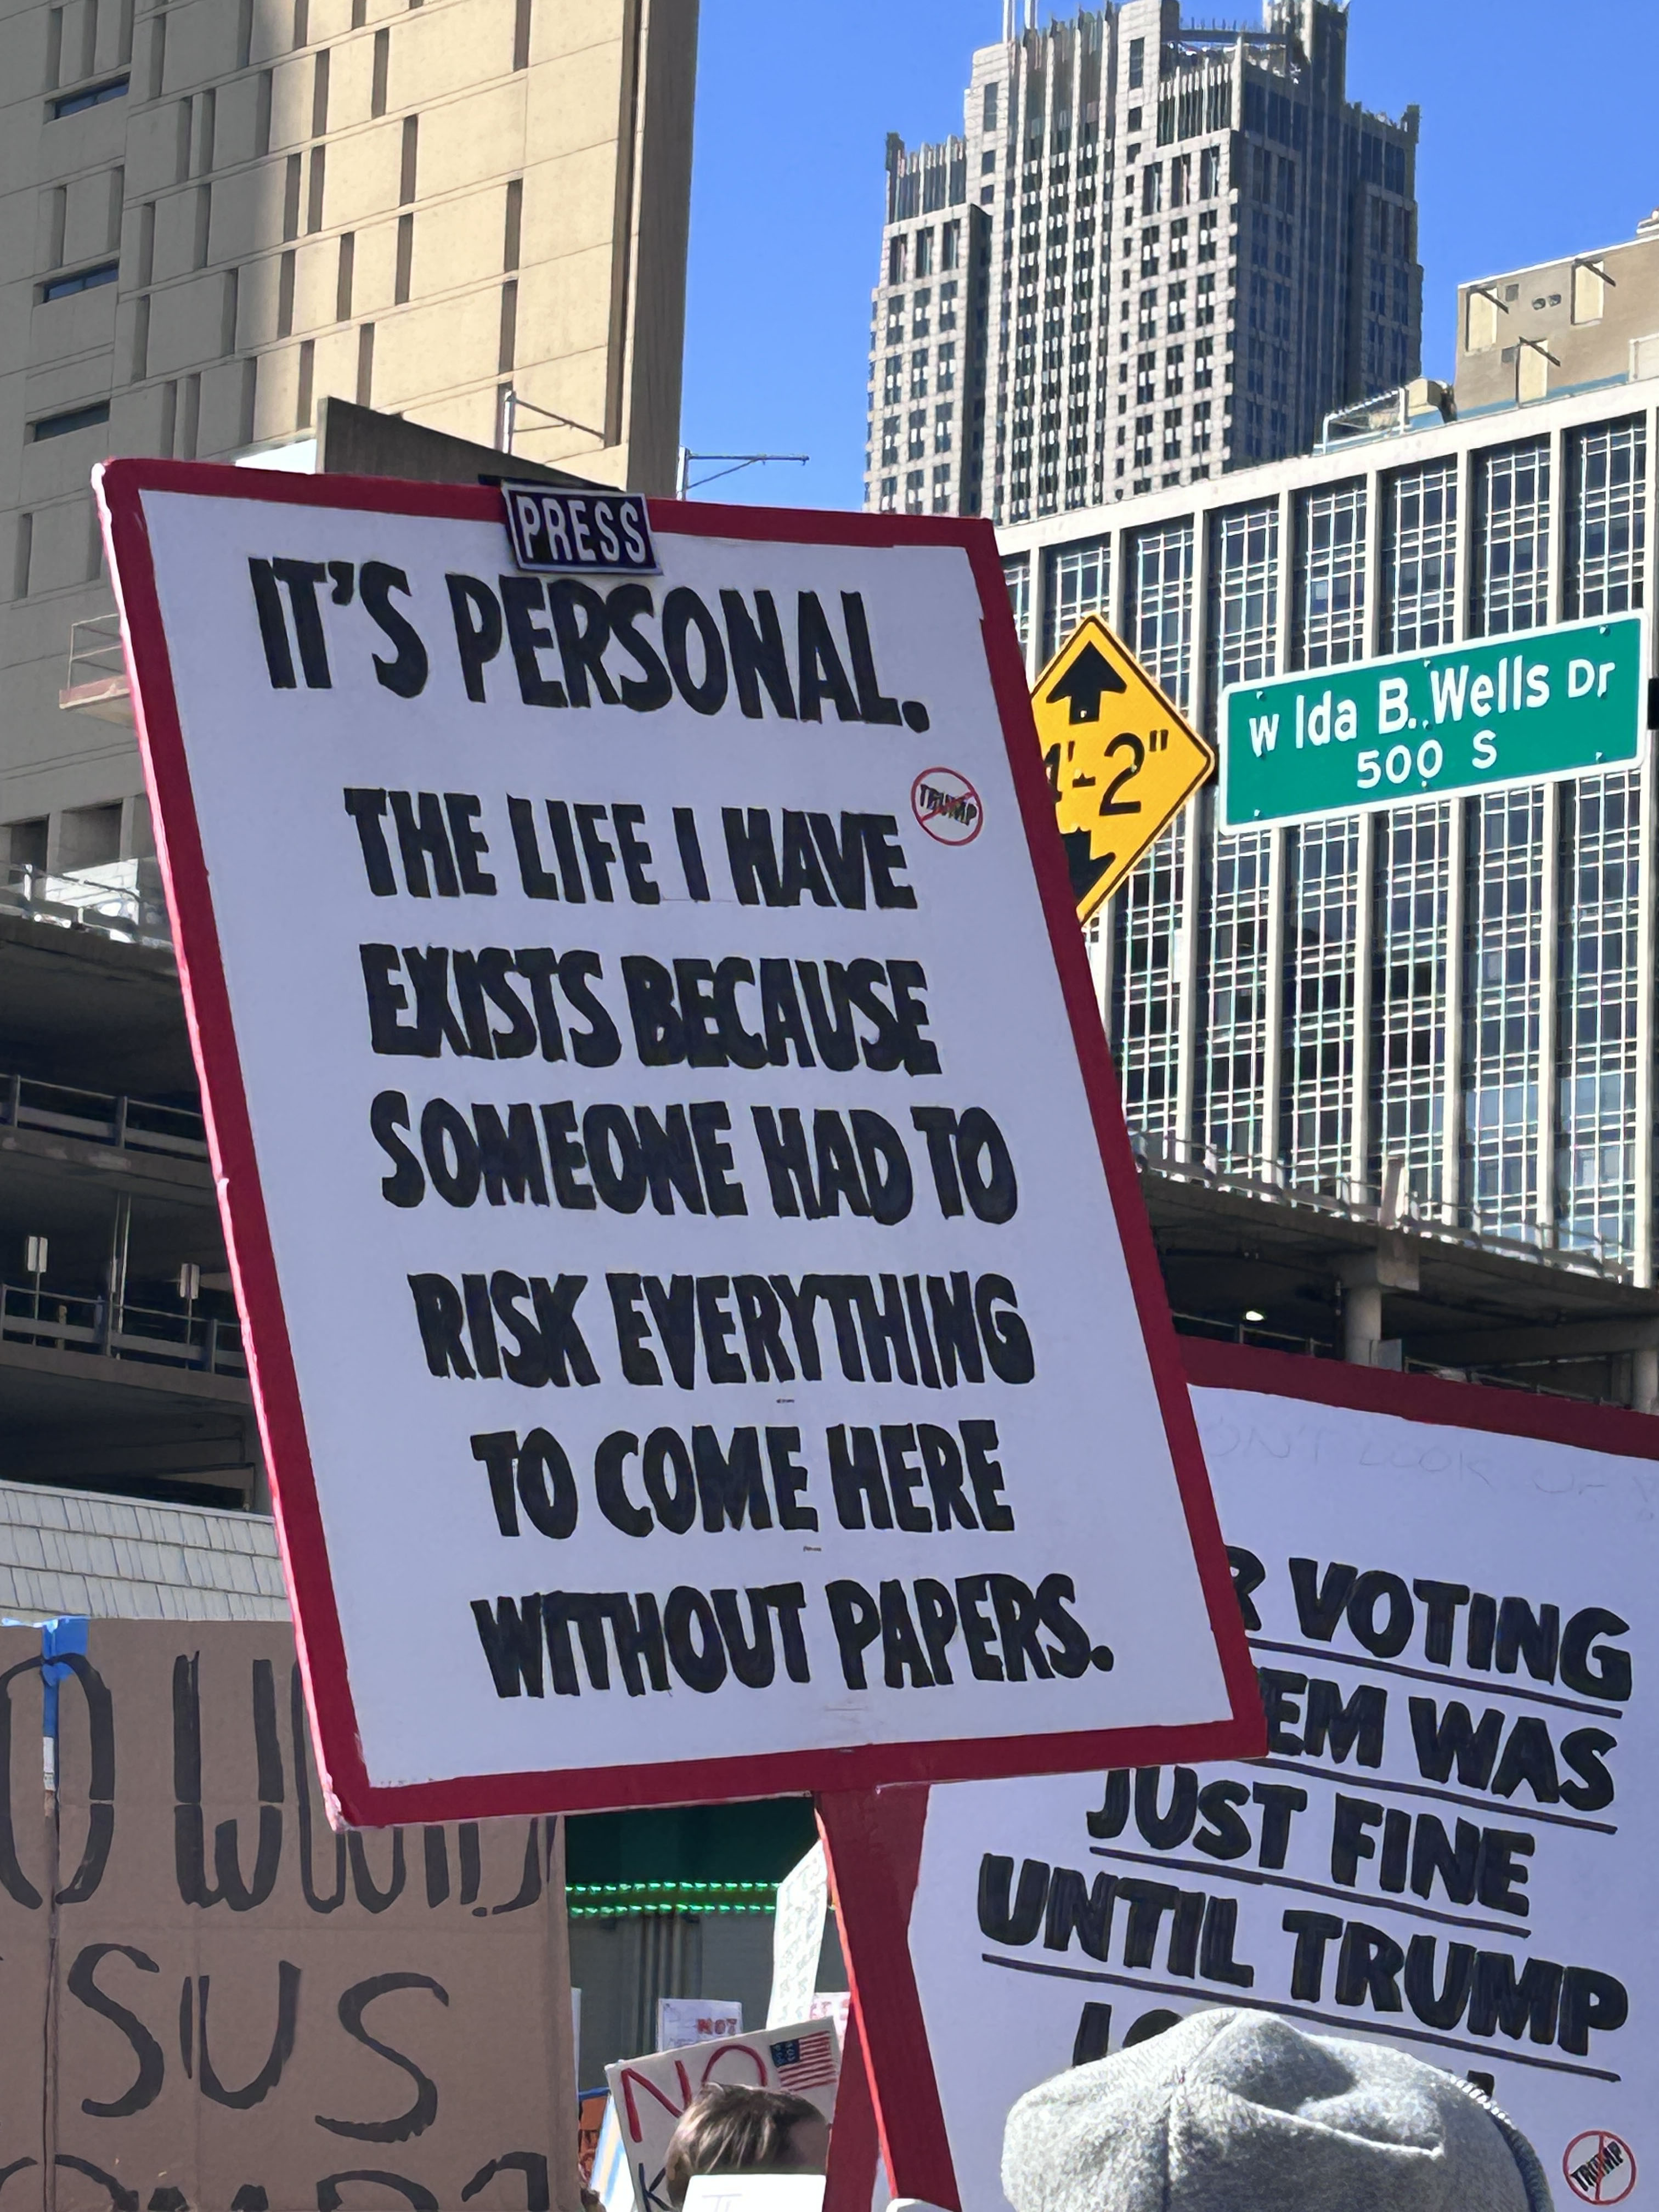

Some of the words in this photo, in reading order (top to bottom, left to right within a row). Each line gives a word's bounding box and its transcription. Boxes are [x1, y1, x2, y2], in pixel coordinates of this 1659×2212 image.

[516, 495, 646, 563] PRESS
[248, 557, 428, 698] IT'S
[445, 572, 930, 733] PERSONAL.
[1295, 690, 1357, 749] Ida
[1378, 677, 1417, 734] B.
[1430, 654, 1550, 725] Wells
[1567, 658, 1616, 698] Dr
[920, 783, 978, 826] TRUMP
[1356, 739, 1443, 789] 500
[1471, 729, 1498, 769] S
[343, 788, 497, 898] THE
[506, 794, 661, 905] LIFE
[672, 808, 710, 902] I
[721, 807, 917, 910] HAVE
[359, 943, 622, 1068] EXISTS
[620, 956, 942, 1076] BECAUSE
[370, 1091, 748, 1217] SOMEONE
[751, 1106, 913, 1226] HAD
[910, 1106, 1018, 1224] TO
[407, 1270, 600, 1388] RISK
[605, 1271, 1035, 1390] EVERYTHING
[470, 1427, 578, 1539] TO
[595, 1425, 819, 1537] COME
[826, 1420, 1014, 1532] HERE
[470, 1582, 810, 1699] WITHOUT
[825, 1573, 1114, 1690] PAPERS.
[1289, 1558, 1632, 1701] VOTING
[1409, 1696, 1617, 1812] WAS
[1087, 1767, 1308, 1870] JUST
[1331, 1793, 1535, 1917] FINE
[978, 1853, 1254, 1988] UNTIL
[1282, 1910, 1628, 2056] TRUMP
[1570, 2141, 1624, 2192] TRUMP
